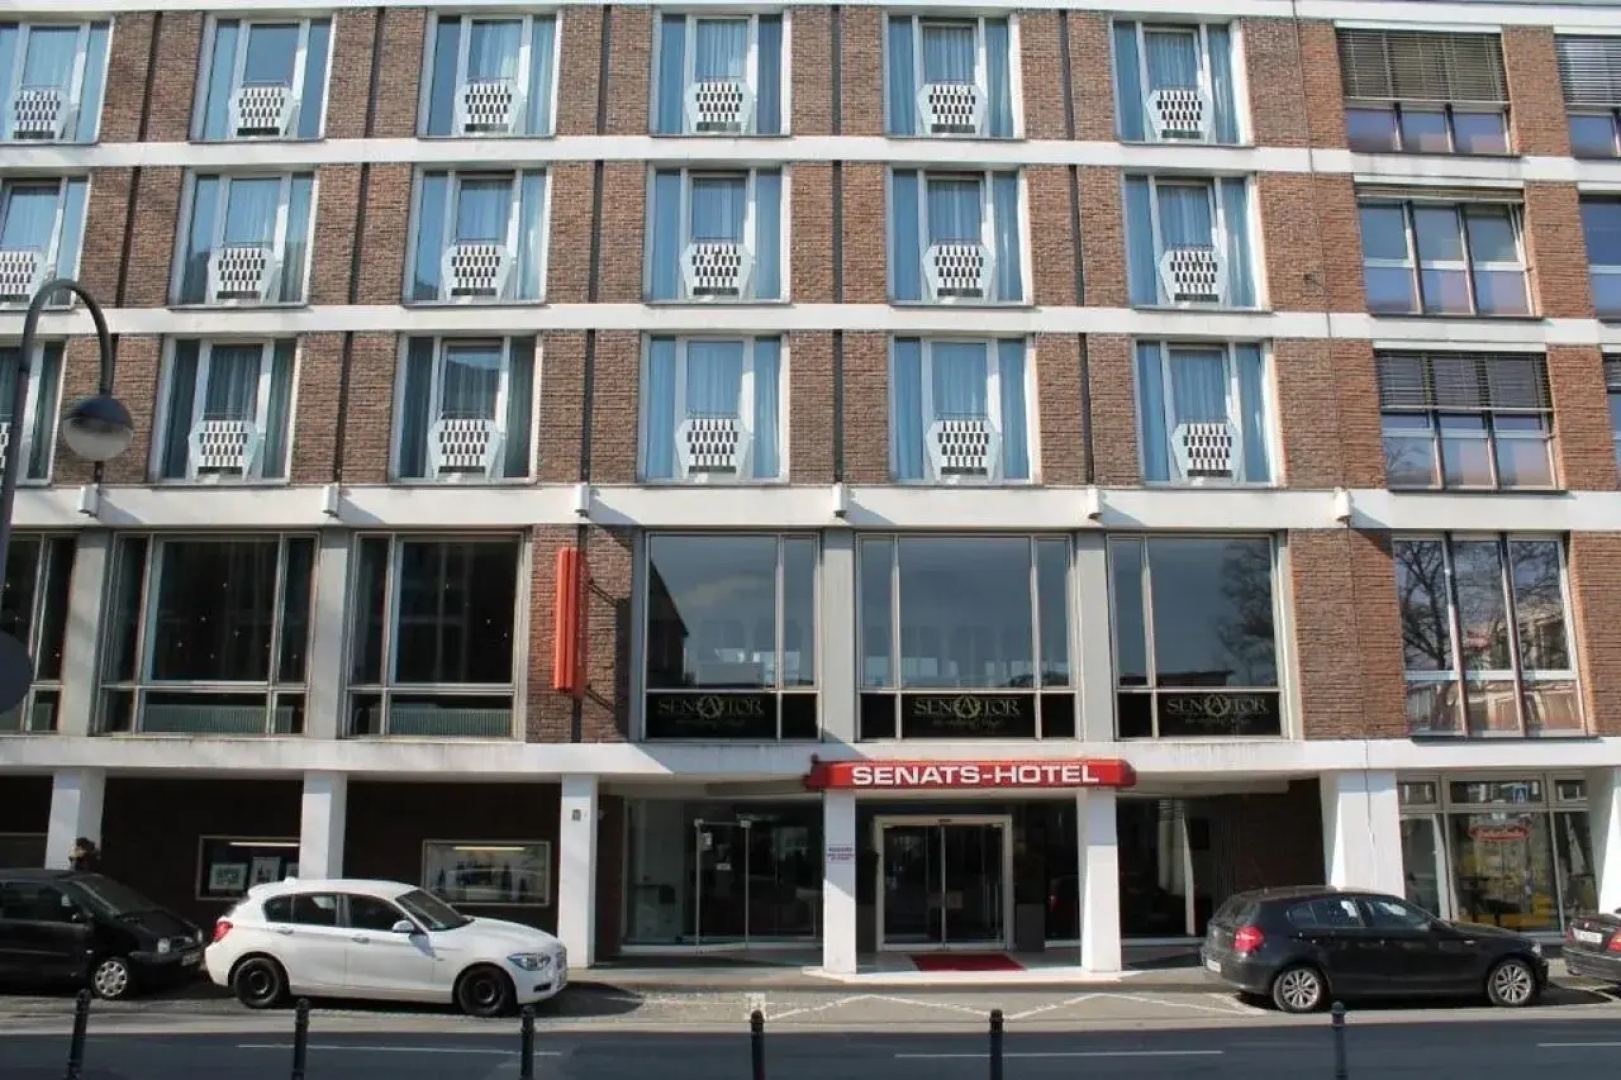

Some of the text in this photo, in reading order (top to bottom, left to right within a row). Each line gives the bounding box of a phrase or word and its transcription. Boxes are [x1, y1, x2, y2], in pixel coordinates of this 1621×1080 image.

[658, 695, 765, 719] SENATOR
[913, 696, 1021, 719] SENATOR
[1166, 695, 1269, 717] SENATOR
[852, 763, 1099, 786] SENATS-HOTEL
